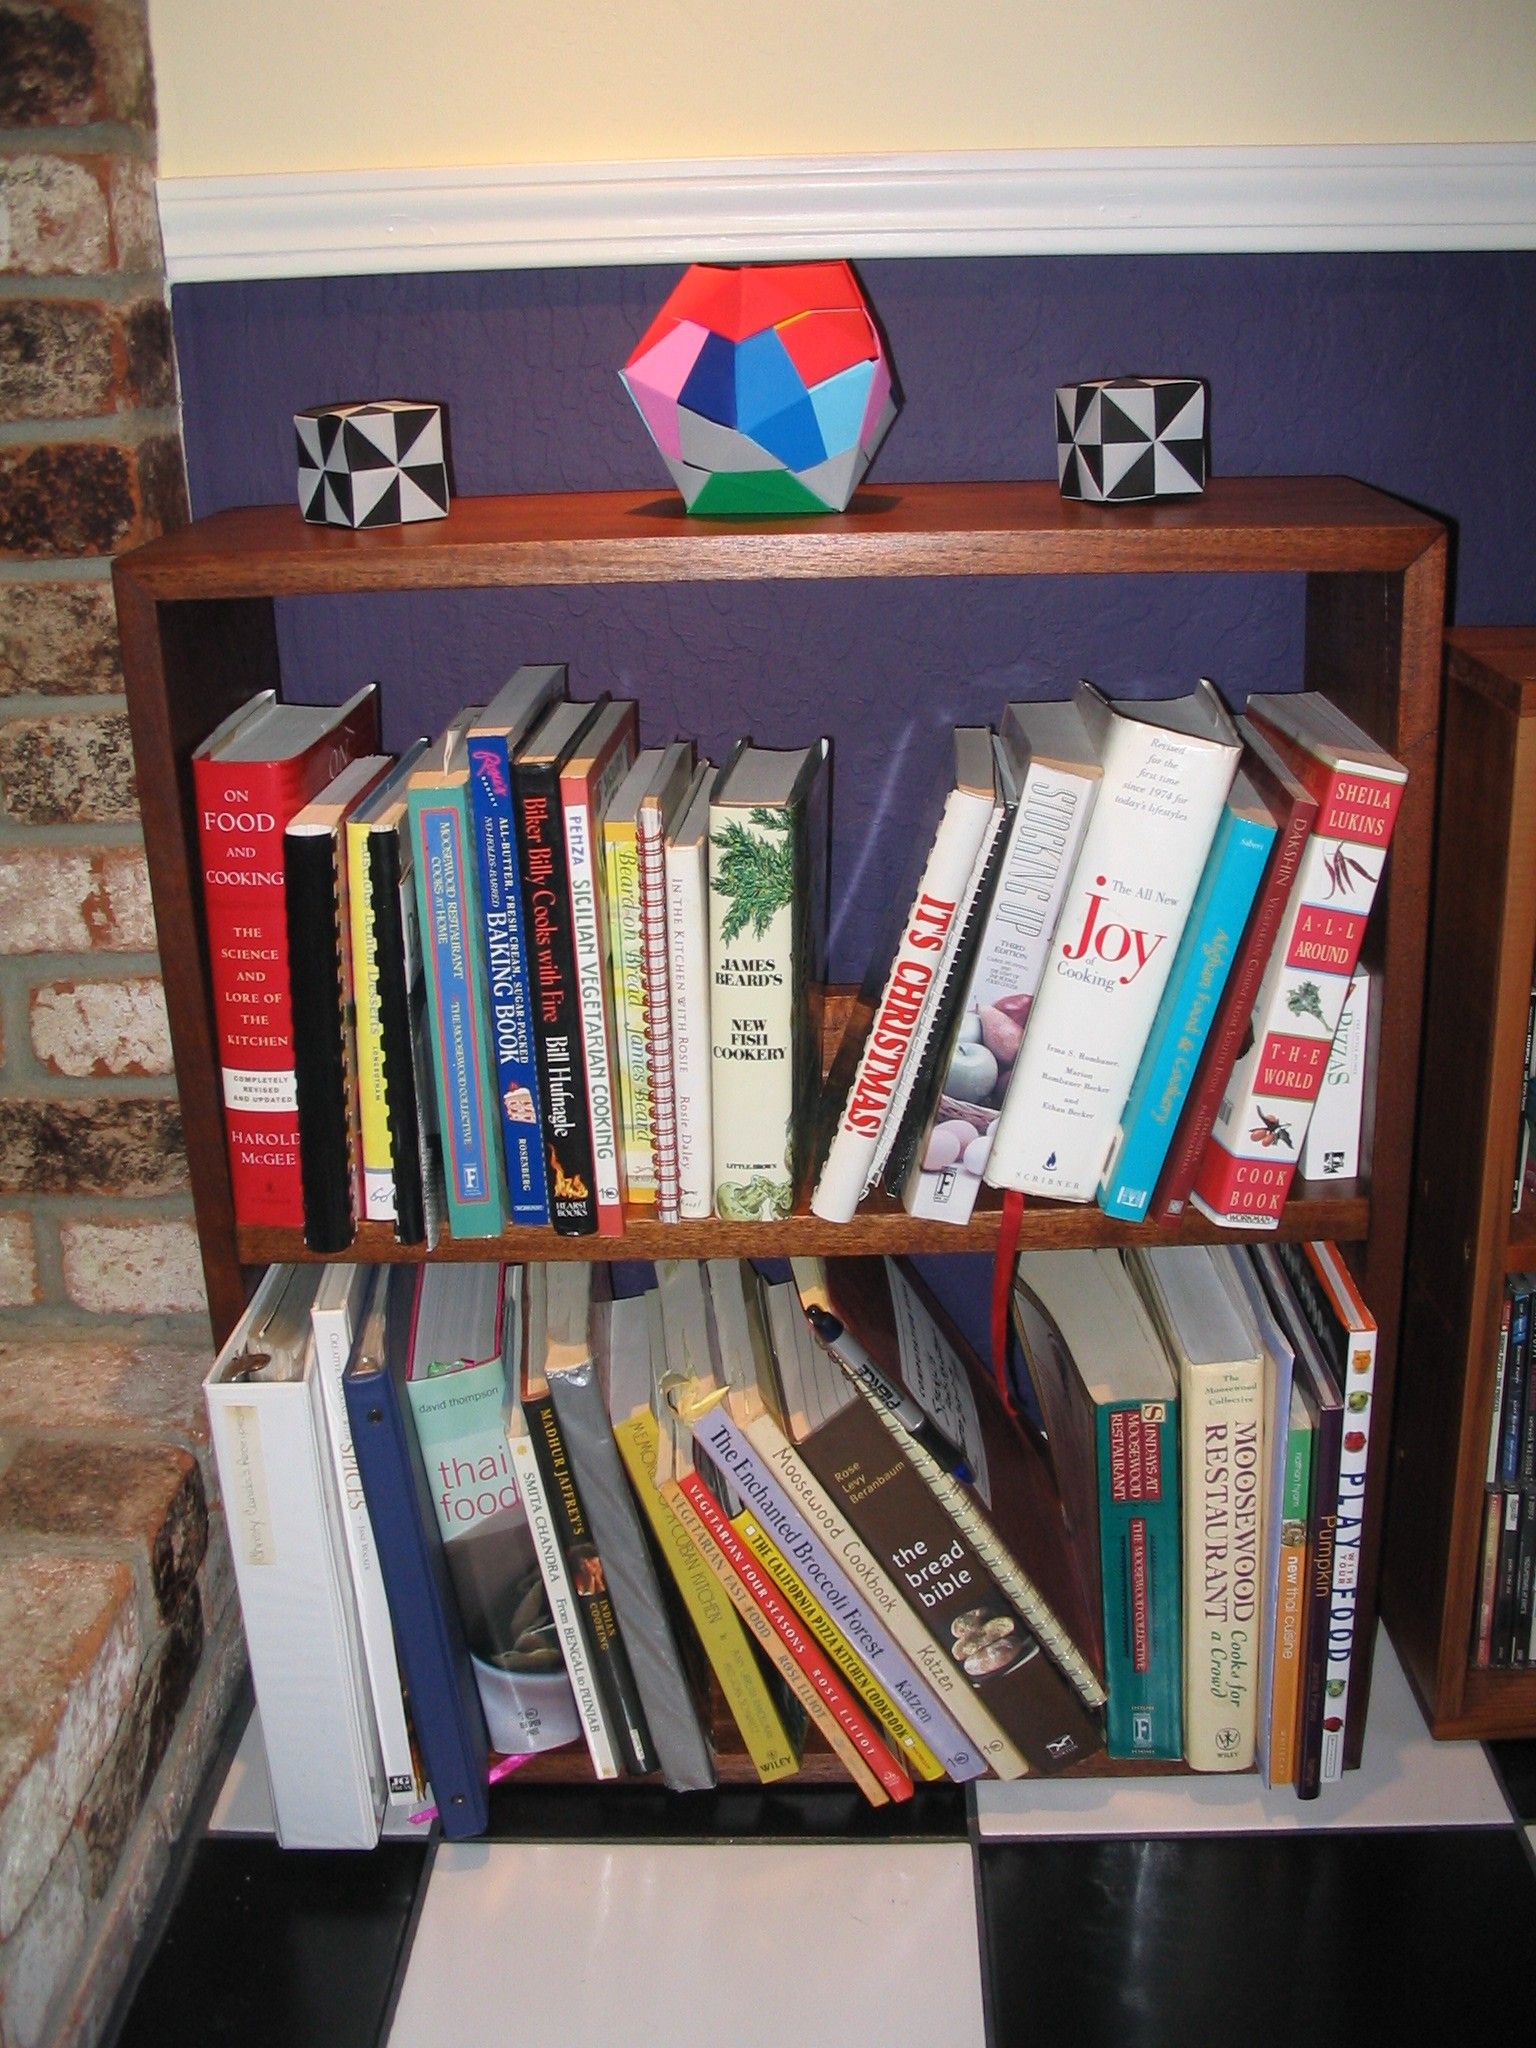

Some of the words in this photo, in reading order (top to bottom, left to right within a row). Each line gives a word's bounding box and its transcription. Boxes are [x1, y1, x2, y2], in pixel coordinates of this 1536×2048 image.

[1145, 754, 1161, 765] for
[1164, 760, 1179, 769] the
[1150, 738, 1187, 755] Revised
[1122, 781, 1146, 793] since
[1149, 787, 1173, 800] 1974
[1172, 793, 1188, 805] for
[1136, 768, 1157, 780] first
[1159, 775, 1180, 785] time
[224, 789, 249, 803] ON
[1115, 795, 1146, 811] today's
[1149, 803, 1188, 822] lifestyles
[1335, 782, 1391, 810] SHEILA
[204, 812, 276, 832] FOOD
[521, 796, 549, 844] Biker
[1328, 809, 1385, 837] LUKINS
[226, 847, 257, 858] AND
[439, 822, 456, 899] MOOSEWOOD
[497, 817, 513, 891] ALL-BUTTER,
[1000, 779, 1080, 904] STOCKING
[1272, 816, 1308, 888] DAKSHIN
[206, 870, 285, 886] COOKING
[429, 856, 443, 894] COOKS
[482, 815, 501, 908] NO-HOLDS-BARRED
[521, 847, 555, 887] Billy
[617, 851, 641, 912] Beard
[1112, 879, 1132, 896] The
[1135, 886, 1153, 901] All
[1155, 891, 1180, 906] New
[435, 909, 448, 944] HOME
[504, 894, 517, 932] FRESH
[530, 888, 561, 946] Cooks
[570, 878, 597, 956] SICILIAN
[672, 898, 684, 924] THE
[905, 891, 956, 955] IT'S
[991, 898, 1047, 939] UP
[1062, 875, 1168, 985] Joy
[233, 927, 262, 938] THE
[446, 901, 464, 980] RESTAURANT
[221, 948, 279, 960] SCIENCE
[484, 911, 514, 998] BAKING
[507, 935, 520, 977] CREAM,
[536, 948, 562, 986] with
[673, 929, 687, 991] KITCHEN
[721, 958, 776, 972] JAMES
[1295, 941, 1349, 965] AROUND
[236, 971, 266, 982] AND
[623, 950, 647, 1007] Bread
[715, 971, 783, 987] BEARD'S
[1057, 960, 1116, 993] Cooking
[225, 991, 259, 1004] LORE
[263, 993, 282, 1004] OF
[539, 989, 567, 1024] Fire
[675, 996, 687, 1031] WITH
[240, 1014, 269, 1025] THE
[493, 1001, 521, 1064] BOOK
[578, 962, 608, 1080] VEGETARIAN
[731, 1019, 768, 1032] NEW
[227, 1034, 289, 1047] KITCHEN
[543, 1035, 570, 1064] Bill
[623, 1020, 650, 1084] James
[677, 1036, 690, 1074] ROSIE
[713, 1045, 787, 1061] COOKERY
[731, 1033, 768, 1046] FISH
[841, 956, 935, 1141] CHRISTMAS!
[1046, 1043, 1066, 1056] Irma
[233, 1075, 289, 1084] COMPLETELY
[243, 1086, 280, 1094] REVISED
[1041, 1071, 1083, 1088] Rombauer
[1065, 1066, 1094, 1079] Marion
[1263, 1067, 1314, 1090] WORLD
[233, 1095, 250, 1103] AND
[252, 1096, 293, 1104] UPDATED
[543, 1066, 577, 1139] Hufnagle
[632, 1087, 655, 1141] Beard
[678, 1095, 691, 1127] Rosie
[1041, 1100, 1066, 1113] Ethan
[1067, 1107, 1096, 1120] Becker
[1064, 1096, 1080, 1106] and
[231, 1130, 301, 1147] HAROLD
[589, 1083, 615, 1160] COOKING
[515, 1136, 533, 1192] ROSENBERG
[678, 1133, 693, 1170] Daley
[1016, 1170, 1081, 1191] SCRIBNER
[1237, 1167, 1287, 1187] COOK
[557, 1209, 588, 1217] BOOKS
[1230, 1191, 1280, 1210] BOOK
[419, 1401, 446, 1413] david
[449, 1387, 498, 1406] thompson
[538, 1407, 567, 1468] MADHUR
[1125, 1413, 1143, 1498] MOOSEWOOD
[1143, 1404, 1164, 1476] SUNDAYS
[338, 1441, 366, 1512] SPICES
[438, 1445, 508, 1489] thai
[834, 1462, 860, 1483] Rose
[1108, 1413, 1127, 1502] RESTAURANT
[440, 1477, 519, 1522] food
[552, 1467, 586, 1536] JAFFREY'S
[842, 1473, 866, 1494] Levy
[849, 1461, 905, 1505] Beranbaum
[521, 1471, 543, 1515] SMITA
[533, 1515, 562, 1584] CHANDRA
[770, 1444, 848, 1542] Moosewood
[838, 1536, 904, 1615] Cookbook
[1203, 1422, 1229, 1624] RESTAURANT
[1230, 1420, 1258, 1622] MOOSEWOOD
[1332, 1471, 1367, 1550] PLAY
[705, 1423, 745, 1466] The
[729, 1455, 806, 1546] Enchanted
[788, 1537, 855, 1614] Broccoli
[839, 1605, 889, 1661] Forest
[892, 1540, 928, 1568] the
[1309, 1514, 1337, 1598] Pumpkin
[667, 1491, 730, 1572] VEGETARIAN
[721, 1572, 748, 1603] FAST
[742, 1604, 772, 1640] FOOD
[685, 1483, 746, 1564] VEGETARIAN
[739, 1562, 770, 1599] FOUR
[762, 1598, 808, 1656] SEASONS
[905, 1539, 965, 1588] bread
[1285, 1556, 1299, 1584] new
[1336, 1553, 1347, 1585] YOUR
[1343, 1552, 1356, 1586] WITH
[688, 1571, 725, 1626] KITCHEN
[918, 1569, 972, 1608] bible
[1284, 1585, 1299, 1613] thai
[554, 1597, 572, 1625] From
[588, 1601, 609, 1651] COOKING
[597, 1598, 617, 1637] INDIAN
[1322, 1584, 1358, 1664] FOOD
[561, 1625, 586, 1676] BENGAL
[749, 1532, 774, 1559] THE
[764, 1554, 819, 1618] CALIFORNIA
[809, 1613, 841, 1649] PIZZA
[830, 1642, 871, 1690] KITCHEN
[863, 1684, 910, 1740] COOKBOOK
[1210, 1631, 1221, 1641] a
[1227, 1629, 1251, 1680] Cooks
[1280, 1615, 1297, 1659] cuisine
[914, 1641, 959, 1694] Katzen
[1209, 1647, 1228, 1698] Crowd
[577, 1686, 601, 1734] PUNJAB
[808, 1665, 841, 1705] ROSE
[836, 1705, 877, 1758] ELLIOT
[891, 1675, 936, 1727] Katzen
[1222, 1680, 1247, 1709] for
[760, 1756, 791, 1771] WILEY
